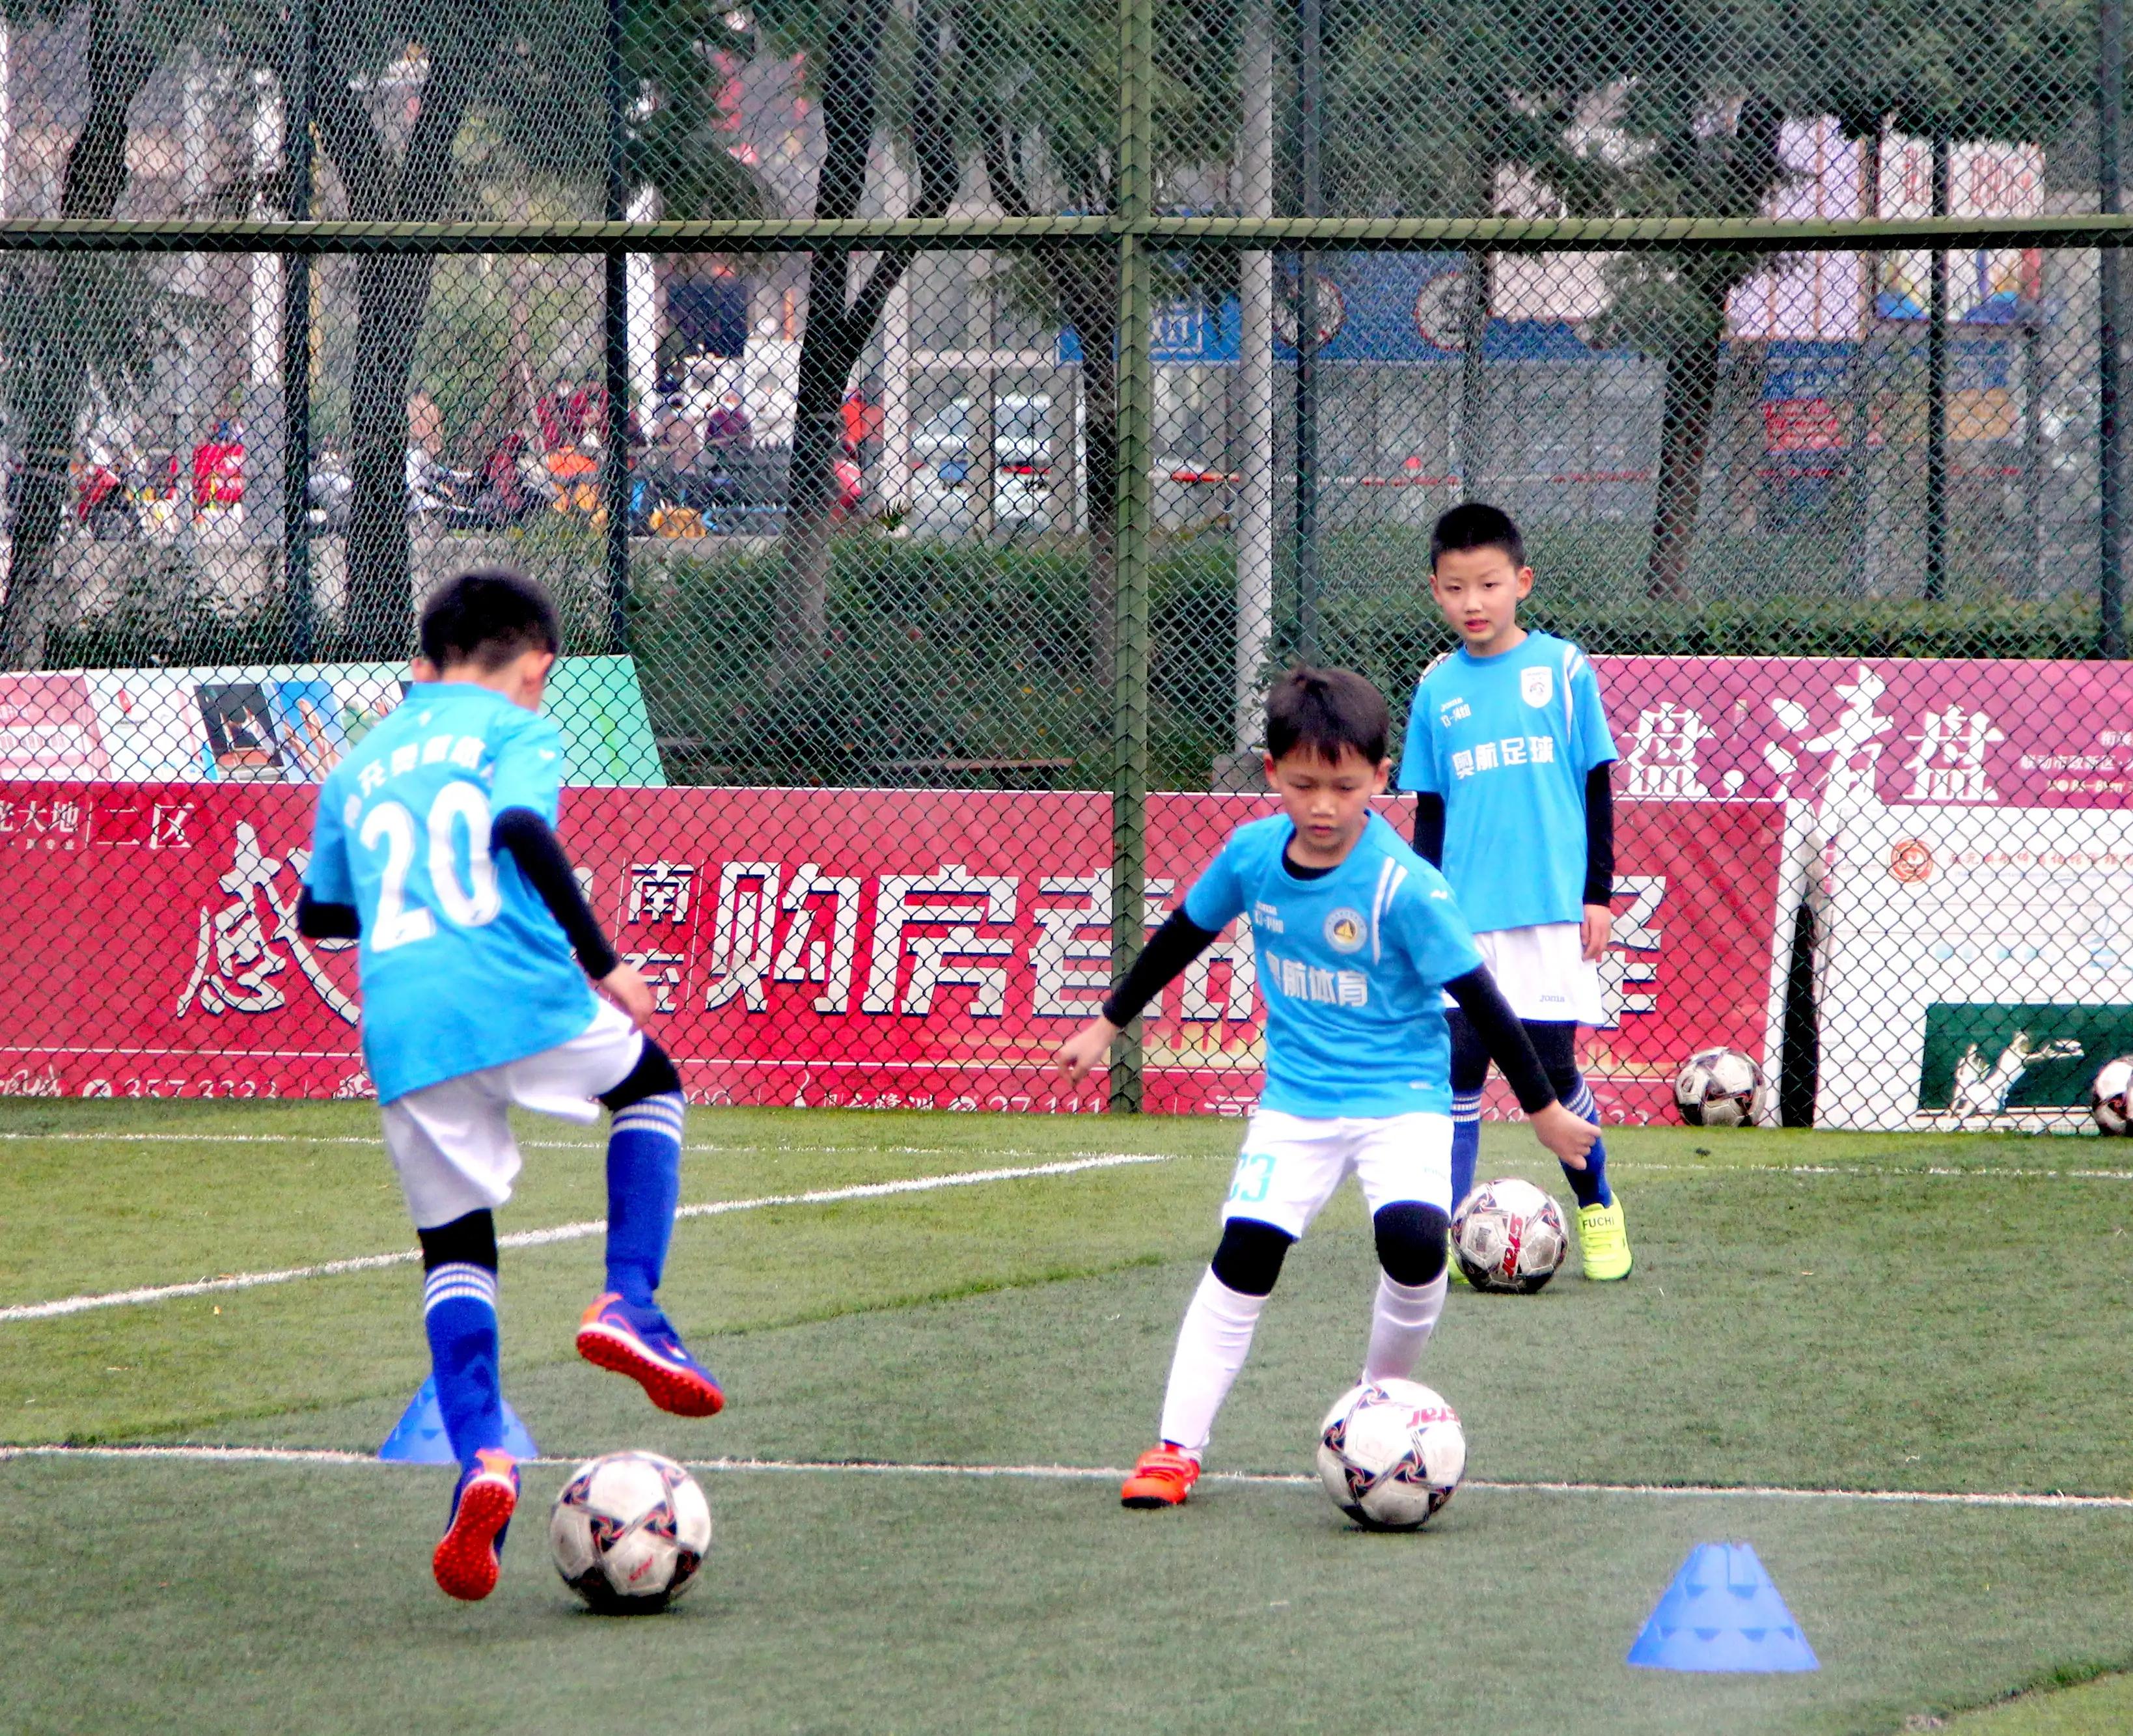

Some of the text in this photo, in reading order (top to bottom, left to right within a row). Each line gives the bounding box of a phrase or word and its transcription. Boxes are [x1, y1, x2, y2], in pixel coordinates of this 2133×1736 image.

[1452, 736, 1554, 780] 奥航足球
[359, 780, 501, 952] 20
